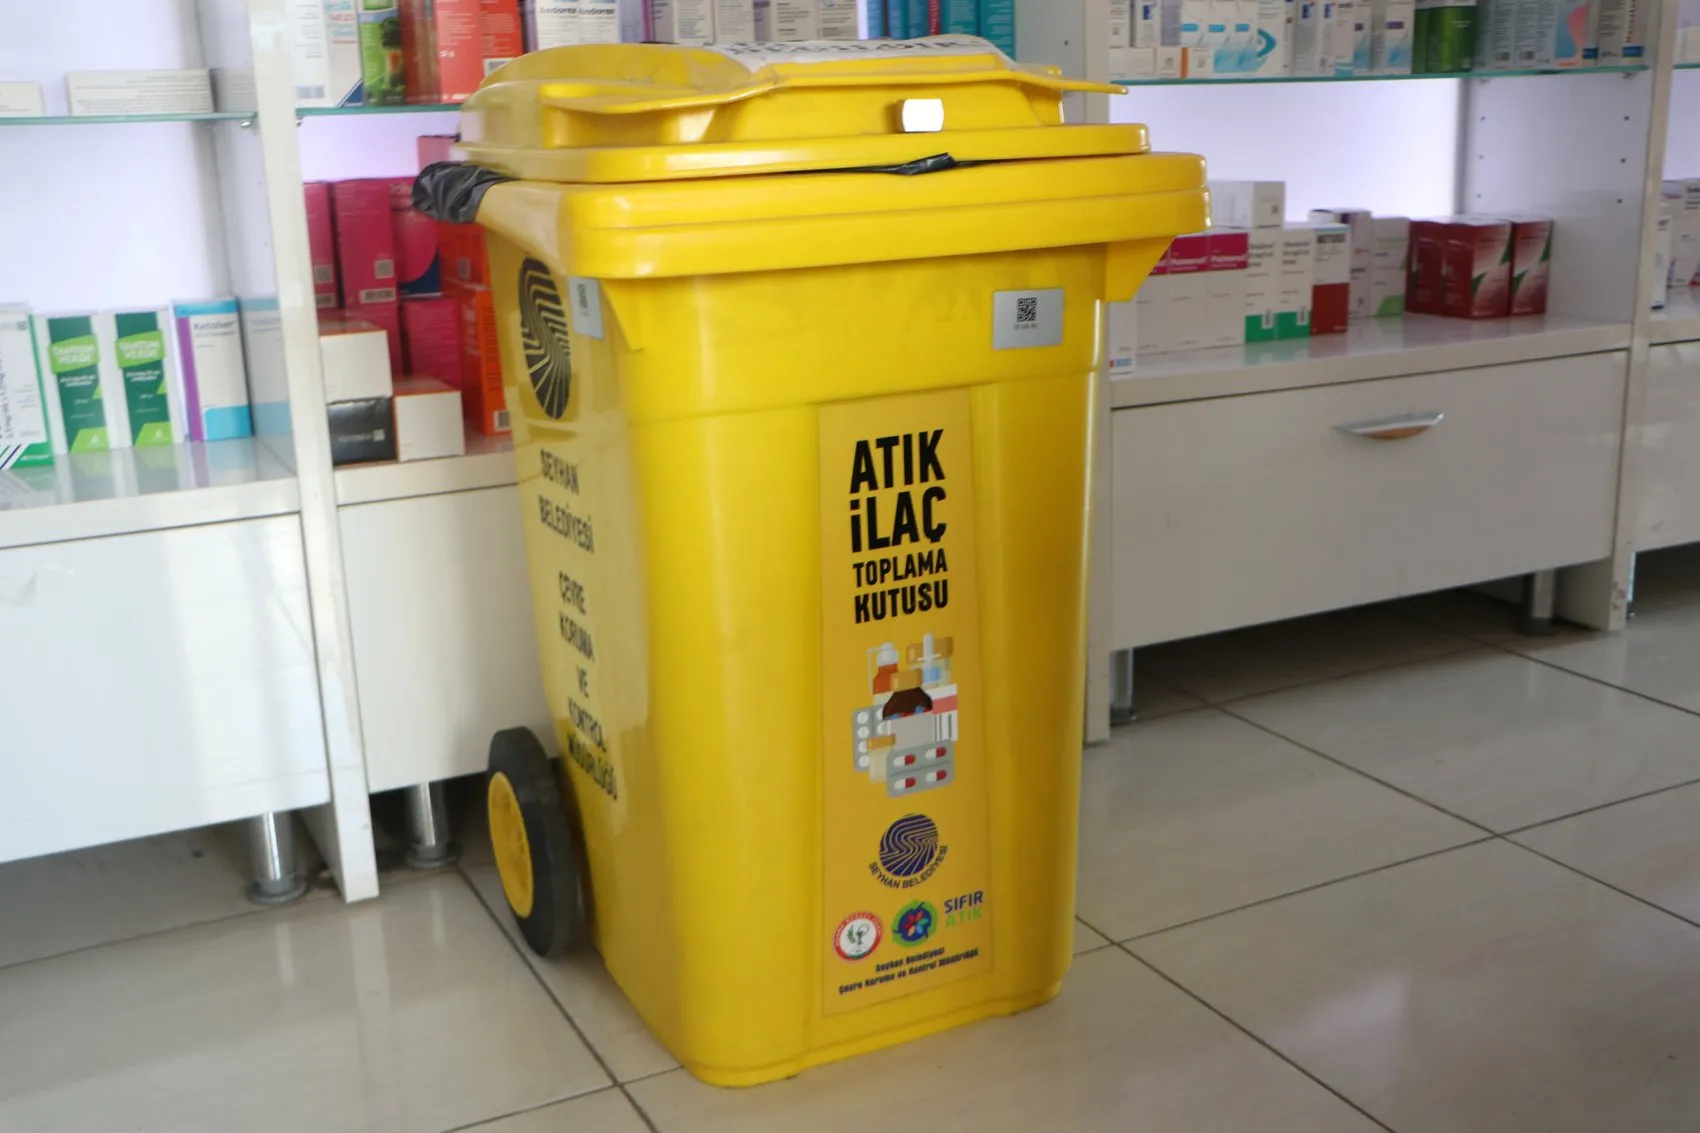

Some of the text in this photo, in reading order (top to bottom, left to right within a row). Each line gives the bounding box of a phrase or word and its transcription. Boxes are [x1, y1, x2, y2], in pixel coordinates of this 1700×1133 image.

[850, 429, 945, 494] ATIK
[853, 548, 948, 588] TOPLAMA
[854, 579, 949, 624] KUTUSU
[868, 861, 900, 889] SEYHAN
[944, 890, 984, 914] SIFIR
